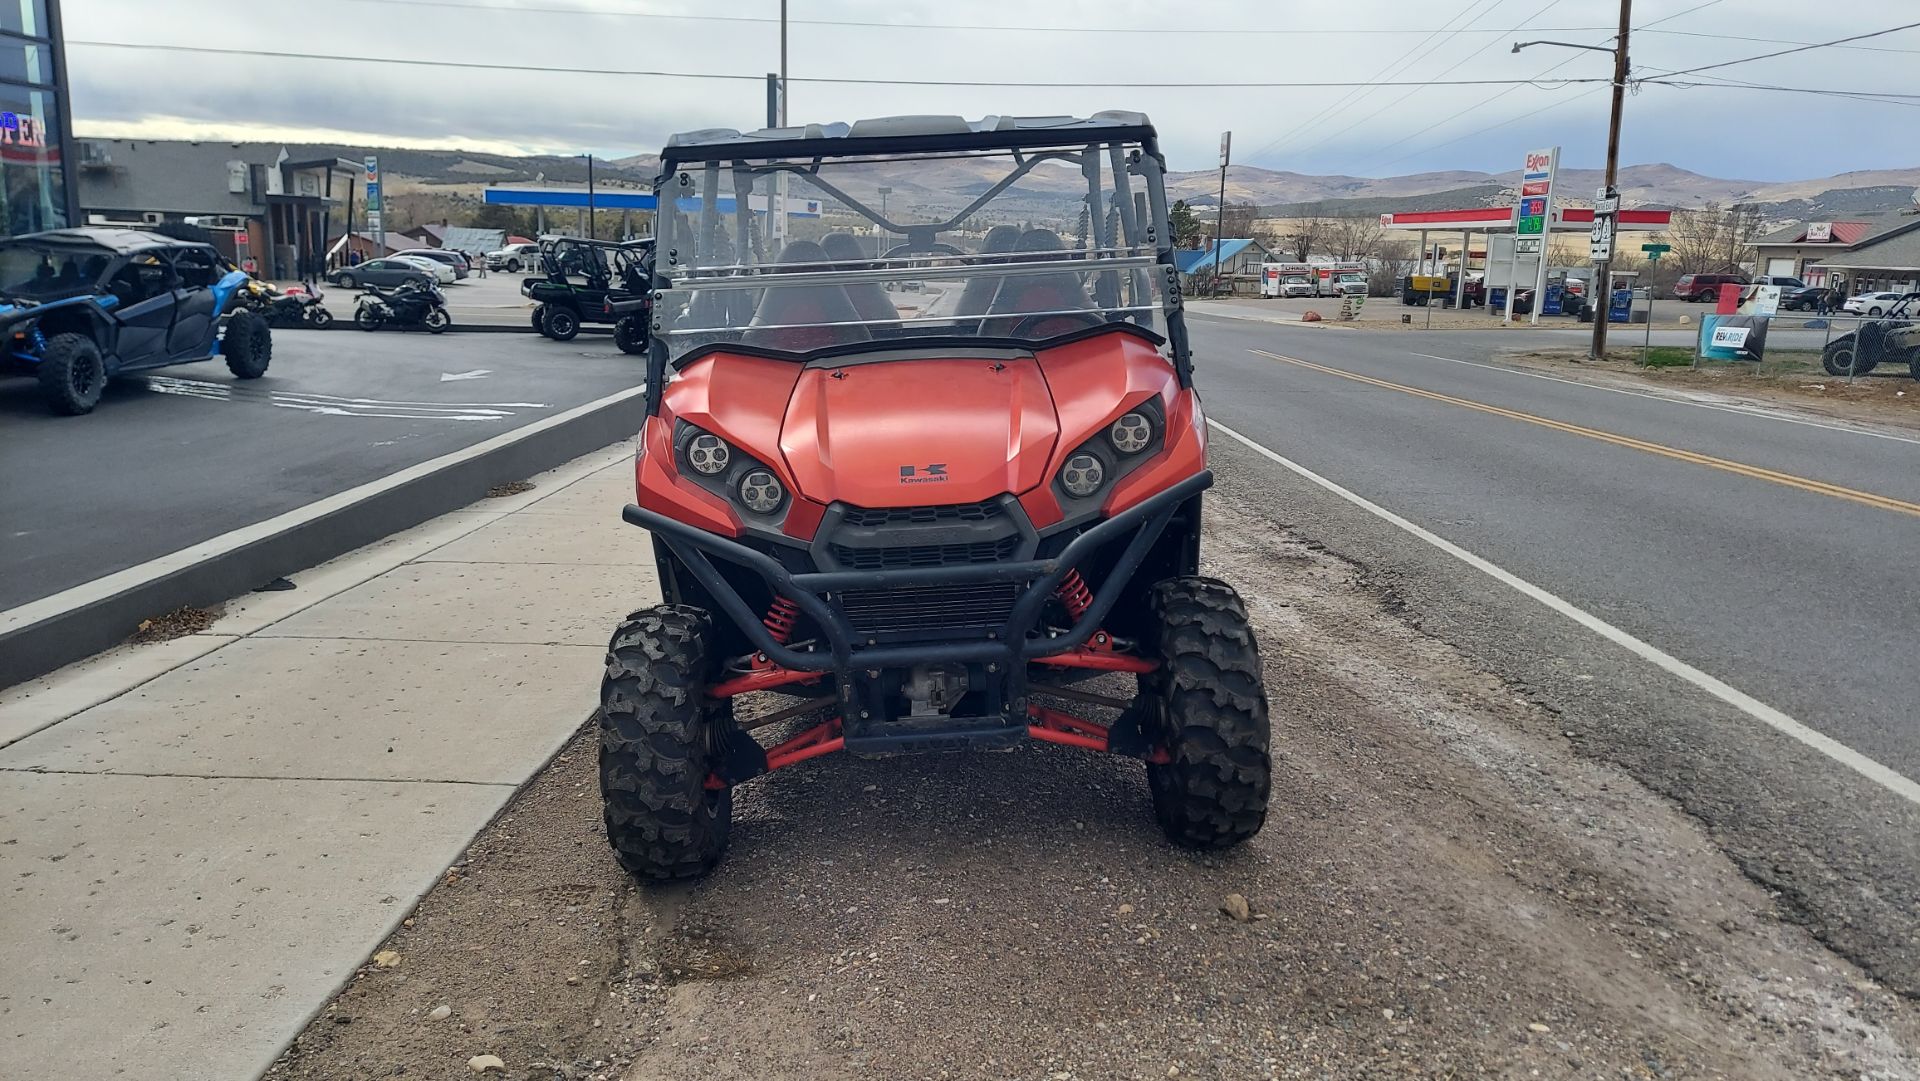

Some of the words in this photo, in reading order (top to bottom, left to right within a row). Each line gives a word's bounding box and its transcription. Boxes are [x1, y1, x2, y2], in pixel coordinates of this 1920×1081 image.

[0, 112, 46, 147] PEN
[1526, 153, 1549, 172] Exxon
[1593, 221, 1601, 236] 89
[901, 476, 949, 484] Kawasaki
